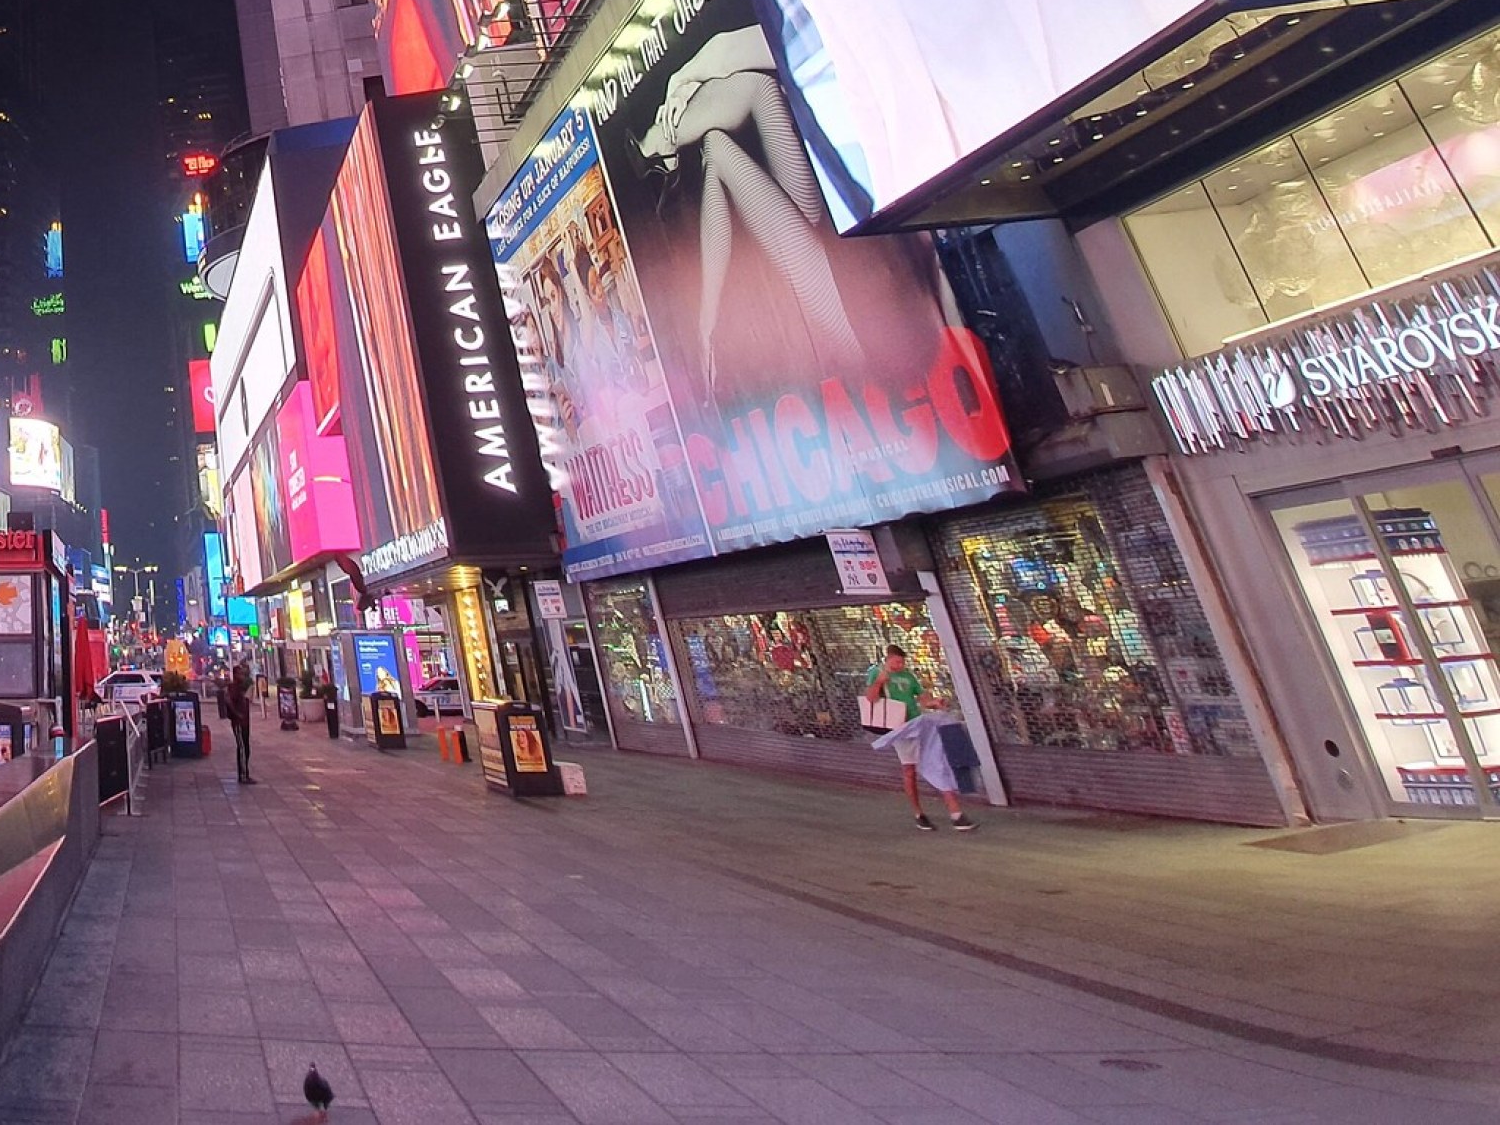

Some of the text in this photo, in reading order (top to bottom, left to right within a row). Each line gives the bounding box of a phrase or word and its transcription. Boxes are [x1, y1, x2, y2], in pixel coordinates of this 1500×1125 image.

[593, 79, 618, 126] AND
[618, 54, 644, 98] ALL
[639, 18, 670, 70] THAT
[533, 117, 576, 184] JANUARY
[574, 107, 584, 132] 5
[412, 129, 518, 495] AMERICAN EAGLE
[564, 427, 654, 522] WAITRESS
[686, 326, 1013, 527] CHICAGO
